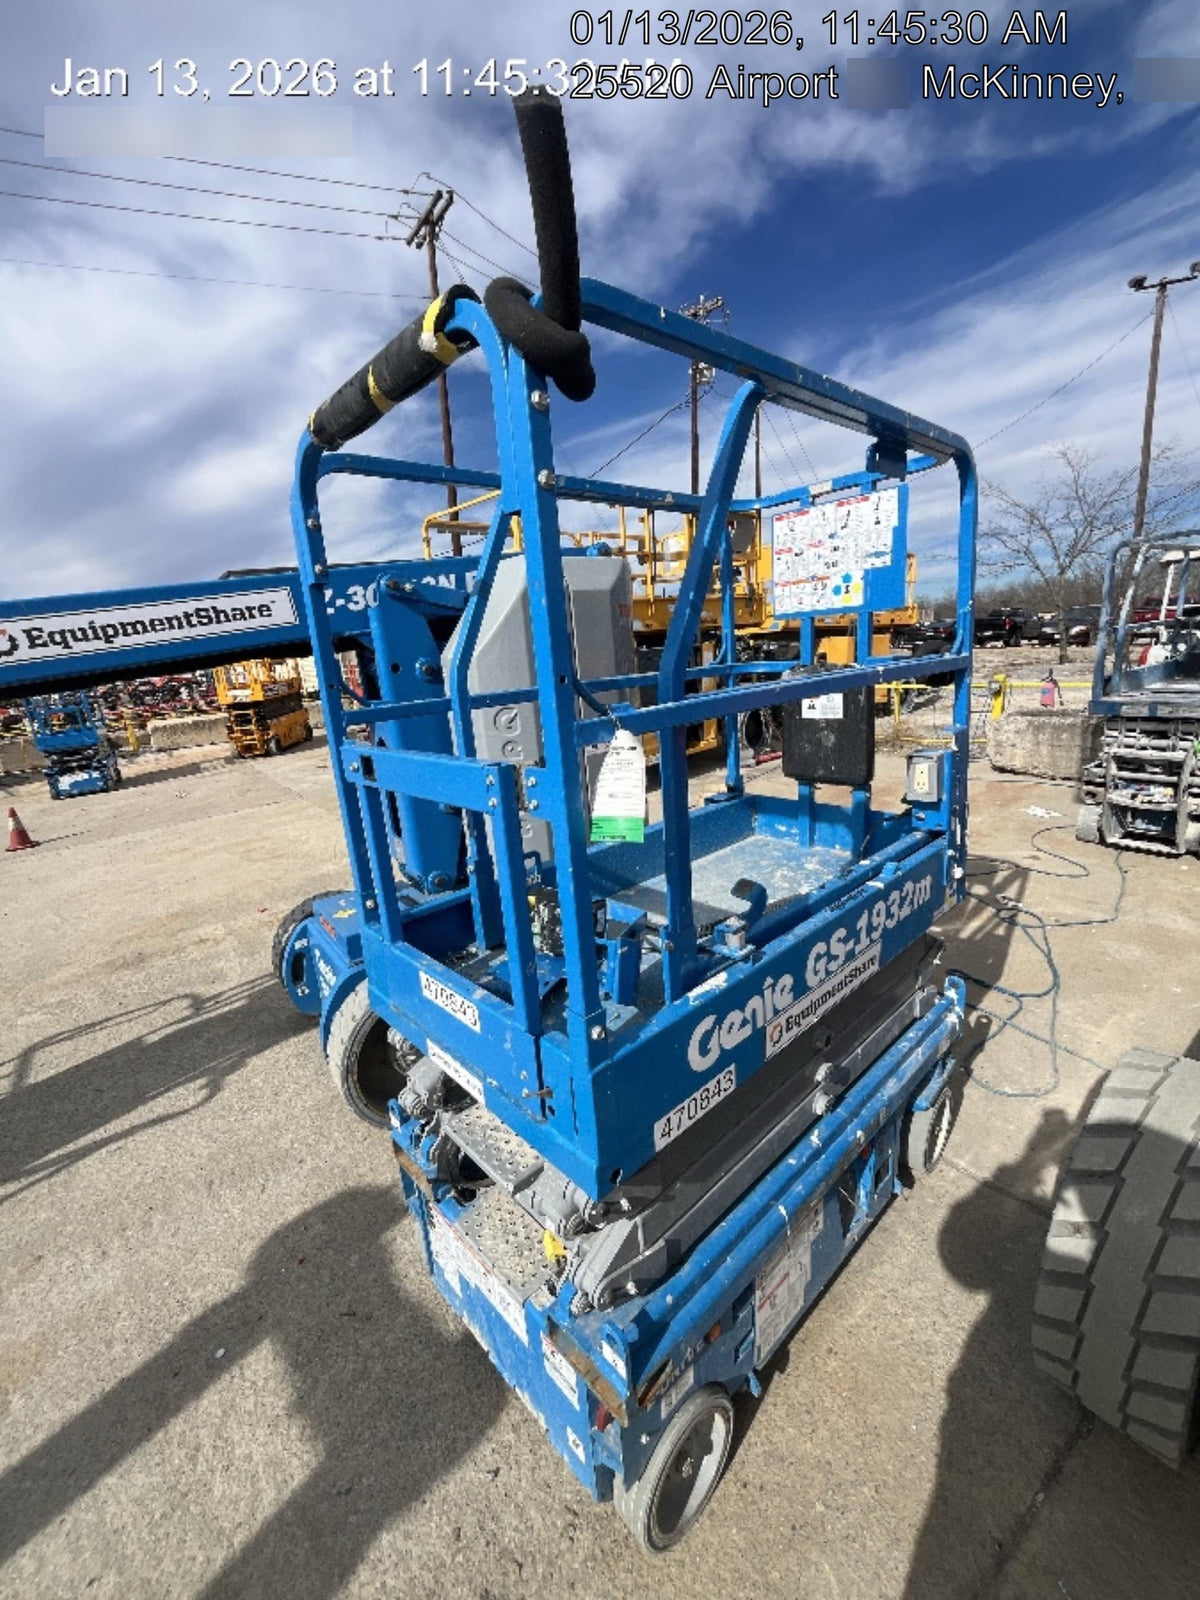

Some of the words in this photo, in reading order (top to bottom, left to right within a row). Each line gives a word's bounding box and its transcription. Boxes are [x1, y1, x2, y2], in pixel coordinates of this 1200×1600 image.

[21, 602, 273, 650] EquipmentShare
[687, 973, 794, 1072] Genie
[805, 874, 932, 988] GS-1932m
[660, 1069, 736, 1139] 470843
